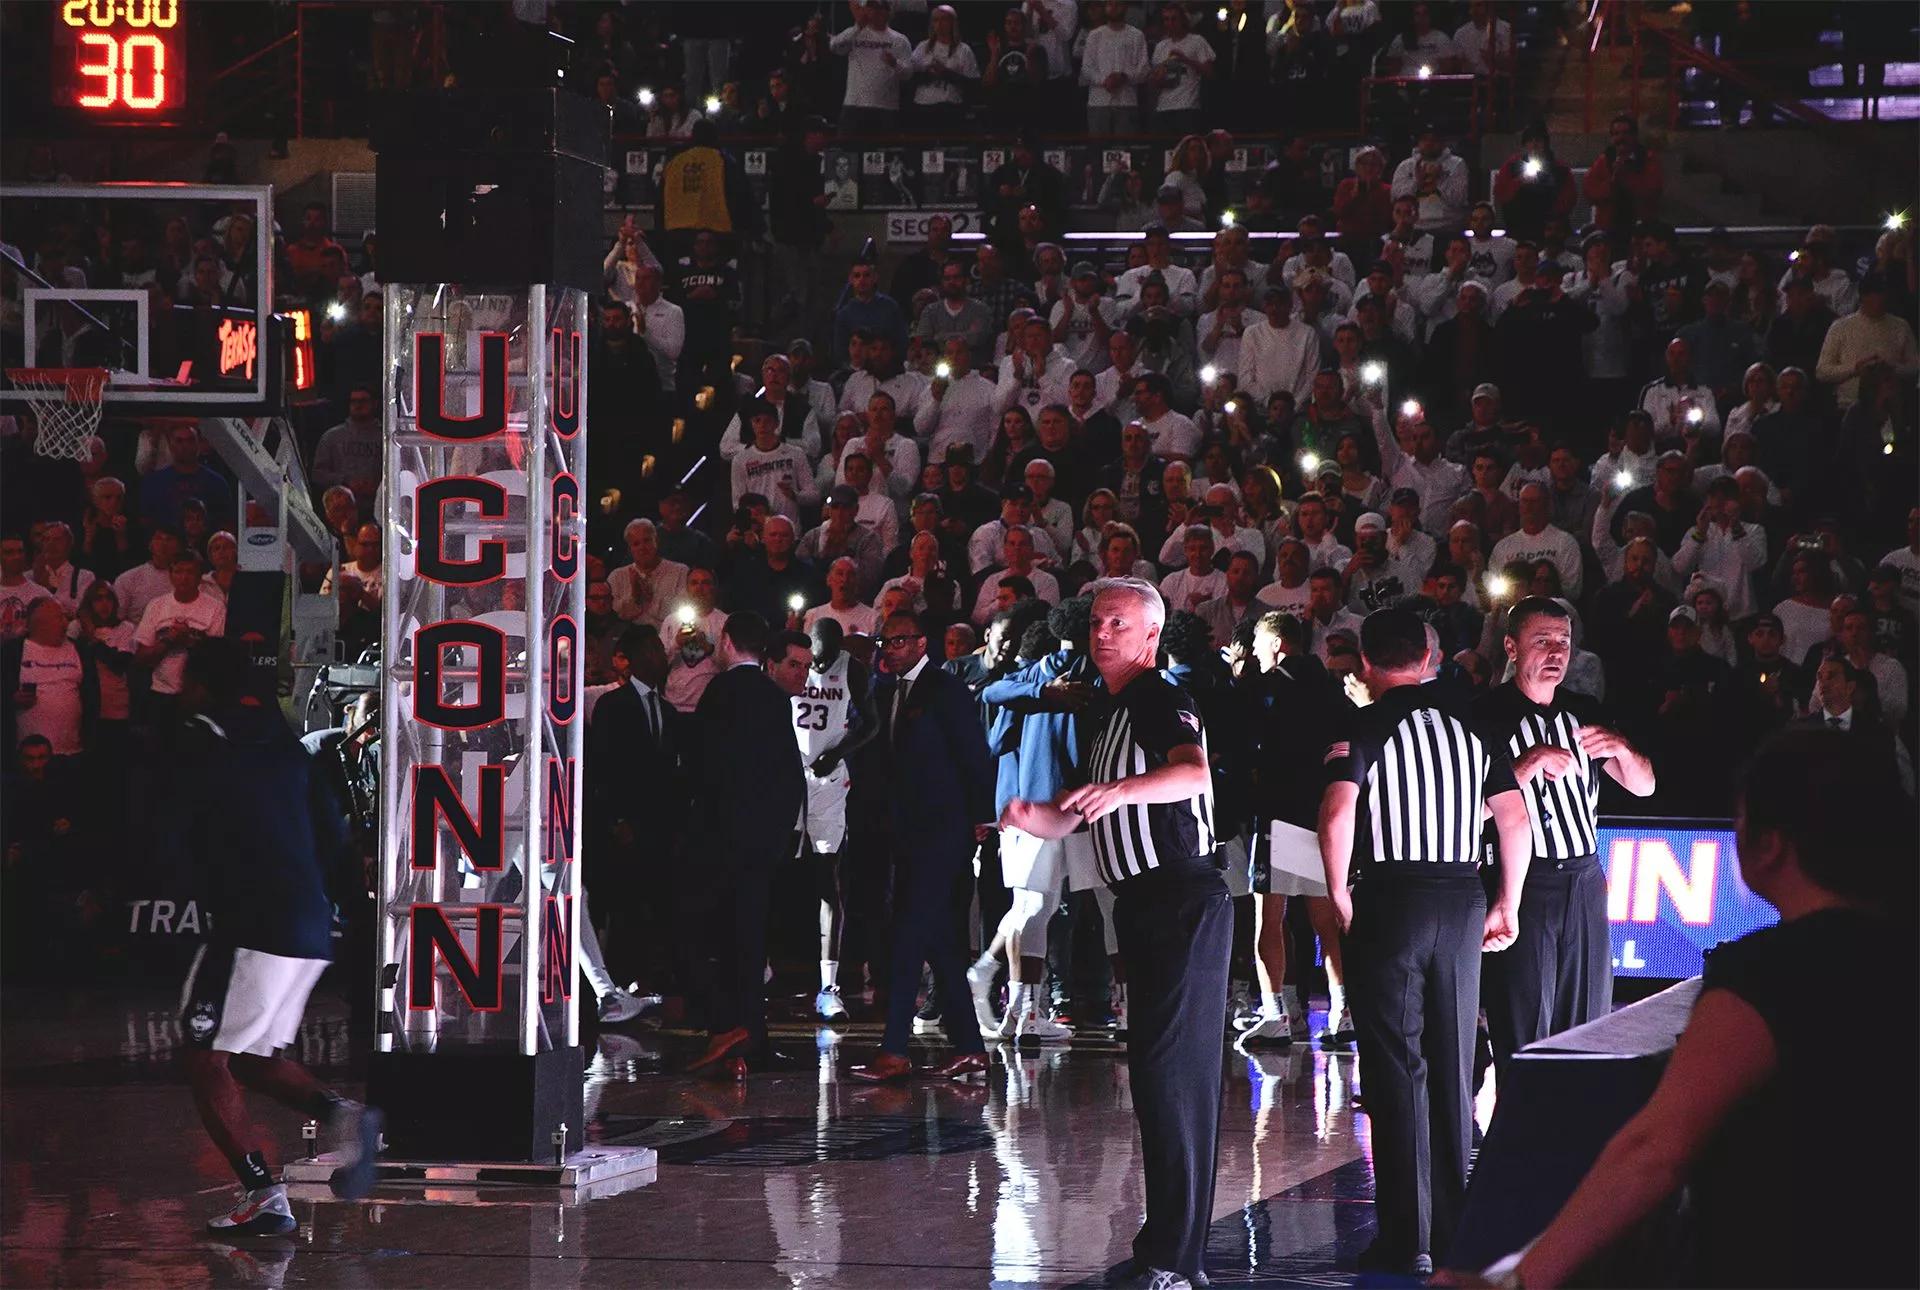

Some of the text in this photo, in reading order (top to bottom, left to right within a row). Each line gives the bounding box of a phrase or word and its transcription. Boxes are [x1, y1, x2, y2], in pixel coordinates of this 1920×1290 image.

[63, 0, 178, 27] 20:00
[79, 33, 165, 109] 30
[410, 332, 508, 1012] UCONN
[547, 328, 579, 1004] UCONN
[797, 702, 829, 731] 23
[128, 900, 213, 935] TRA
